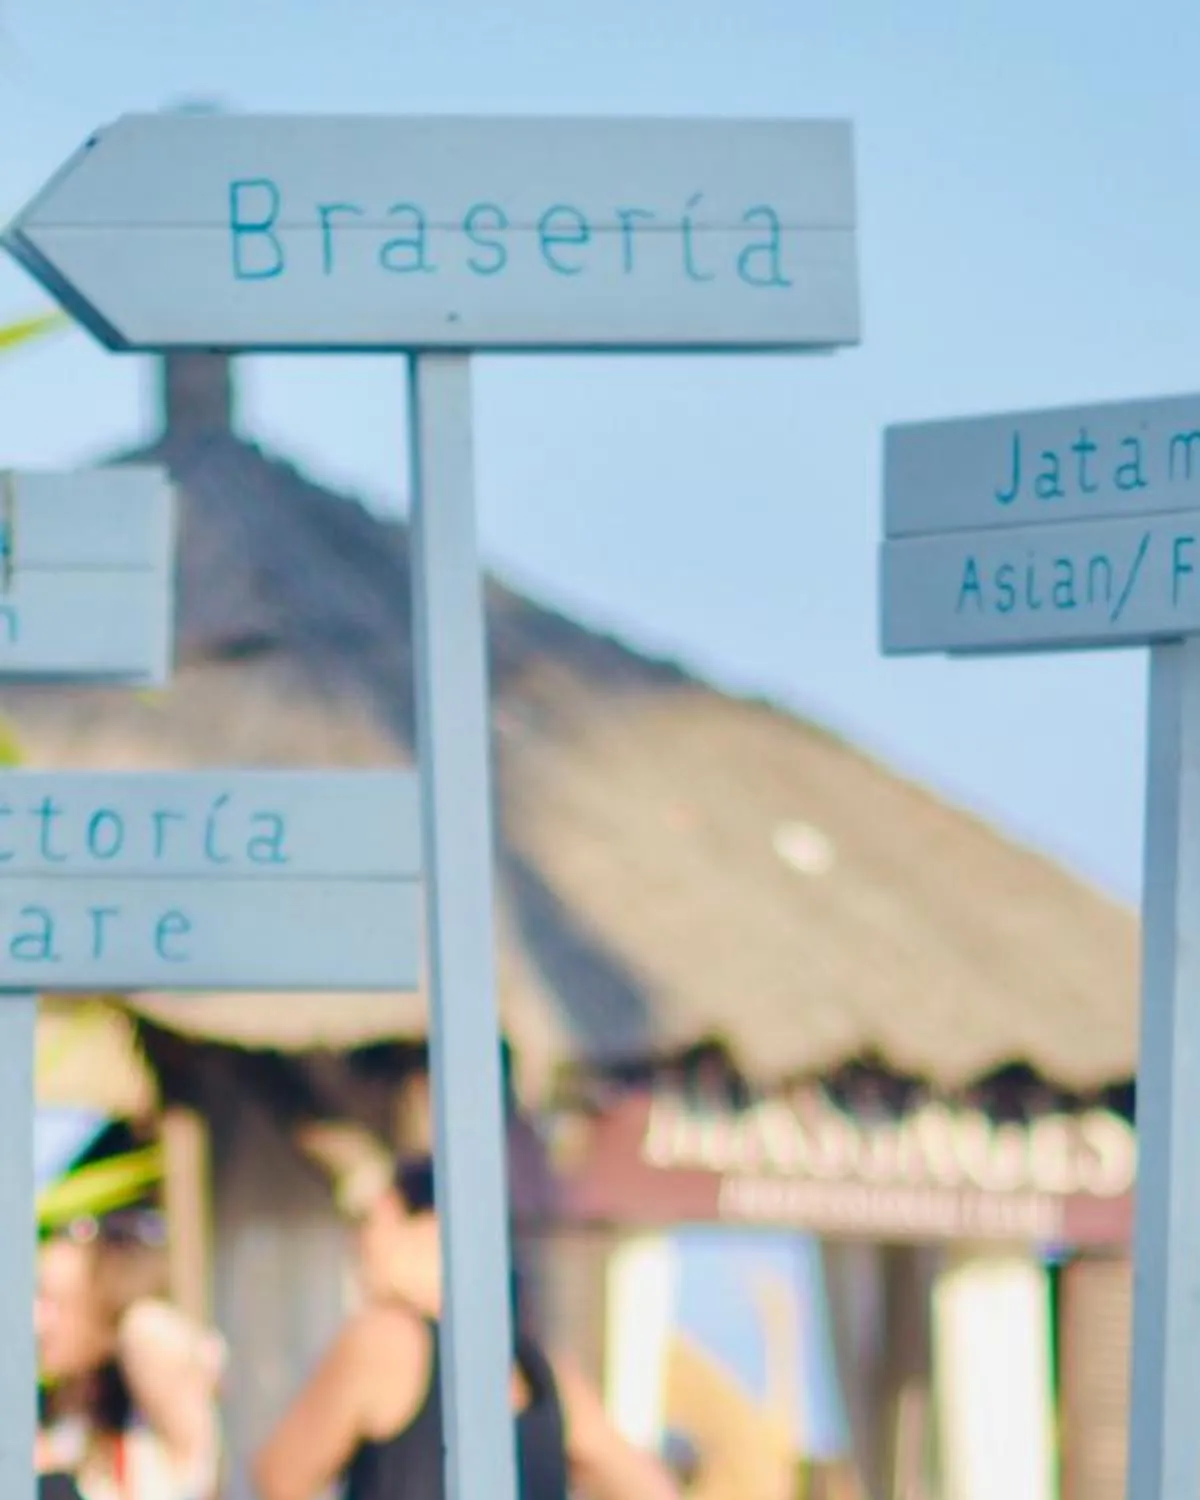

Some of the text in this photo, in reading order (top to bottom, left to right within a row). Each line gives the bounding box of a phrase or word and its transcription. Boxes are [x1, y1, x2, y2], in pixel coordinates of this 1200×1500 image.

[228, 178, 794, 288] Brasería
[955, 531, 1153, 623] Asian/
[8, 904, 193, 962] are
